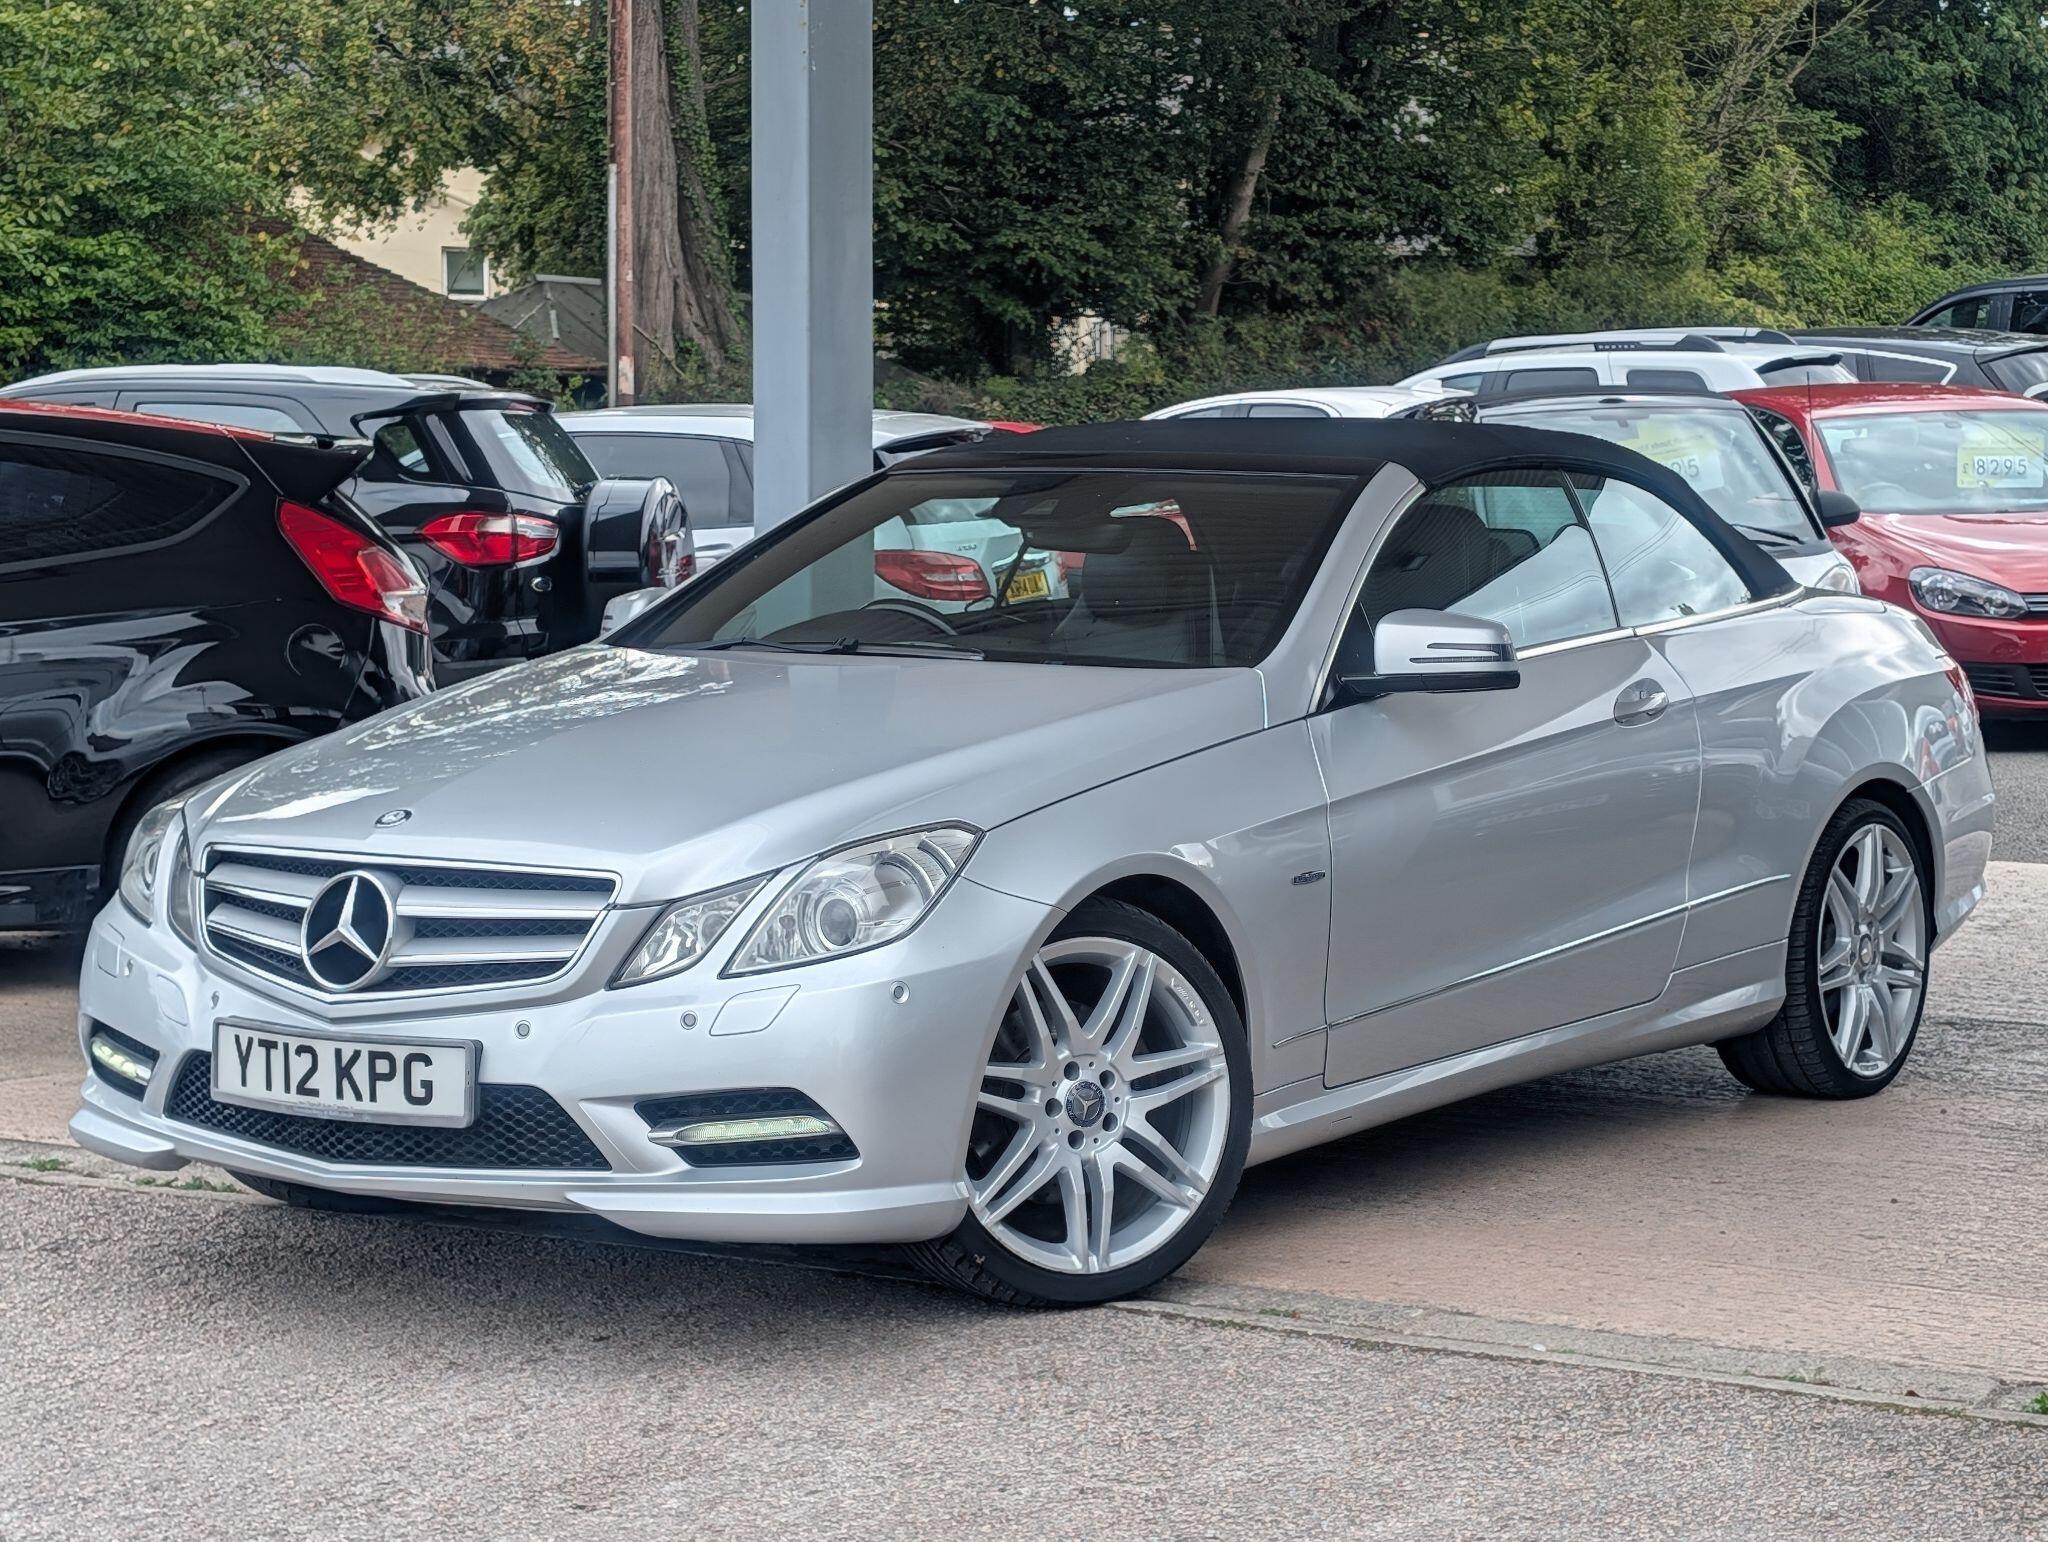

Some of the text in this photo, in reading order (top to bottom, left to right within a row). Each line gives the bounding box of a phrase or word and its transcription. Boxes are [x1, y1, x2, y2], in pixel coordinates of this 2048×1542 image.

[1976, 458, 2027, 476] 8295
[234, 1034, 433, 1107] YT12 KPG
